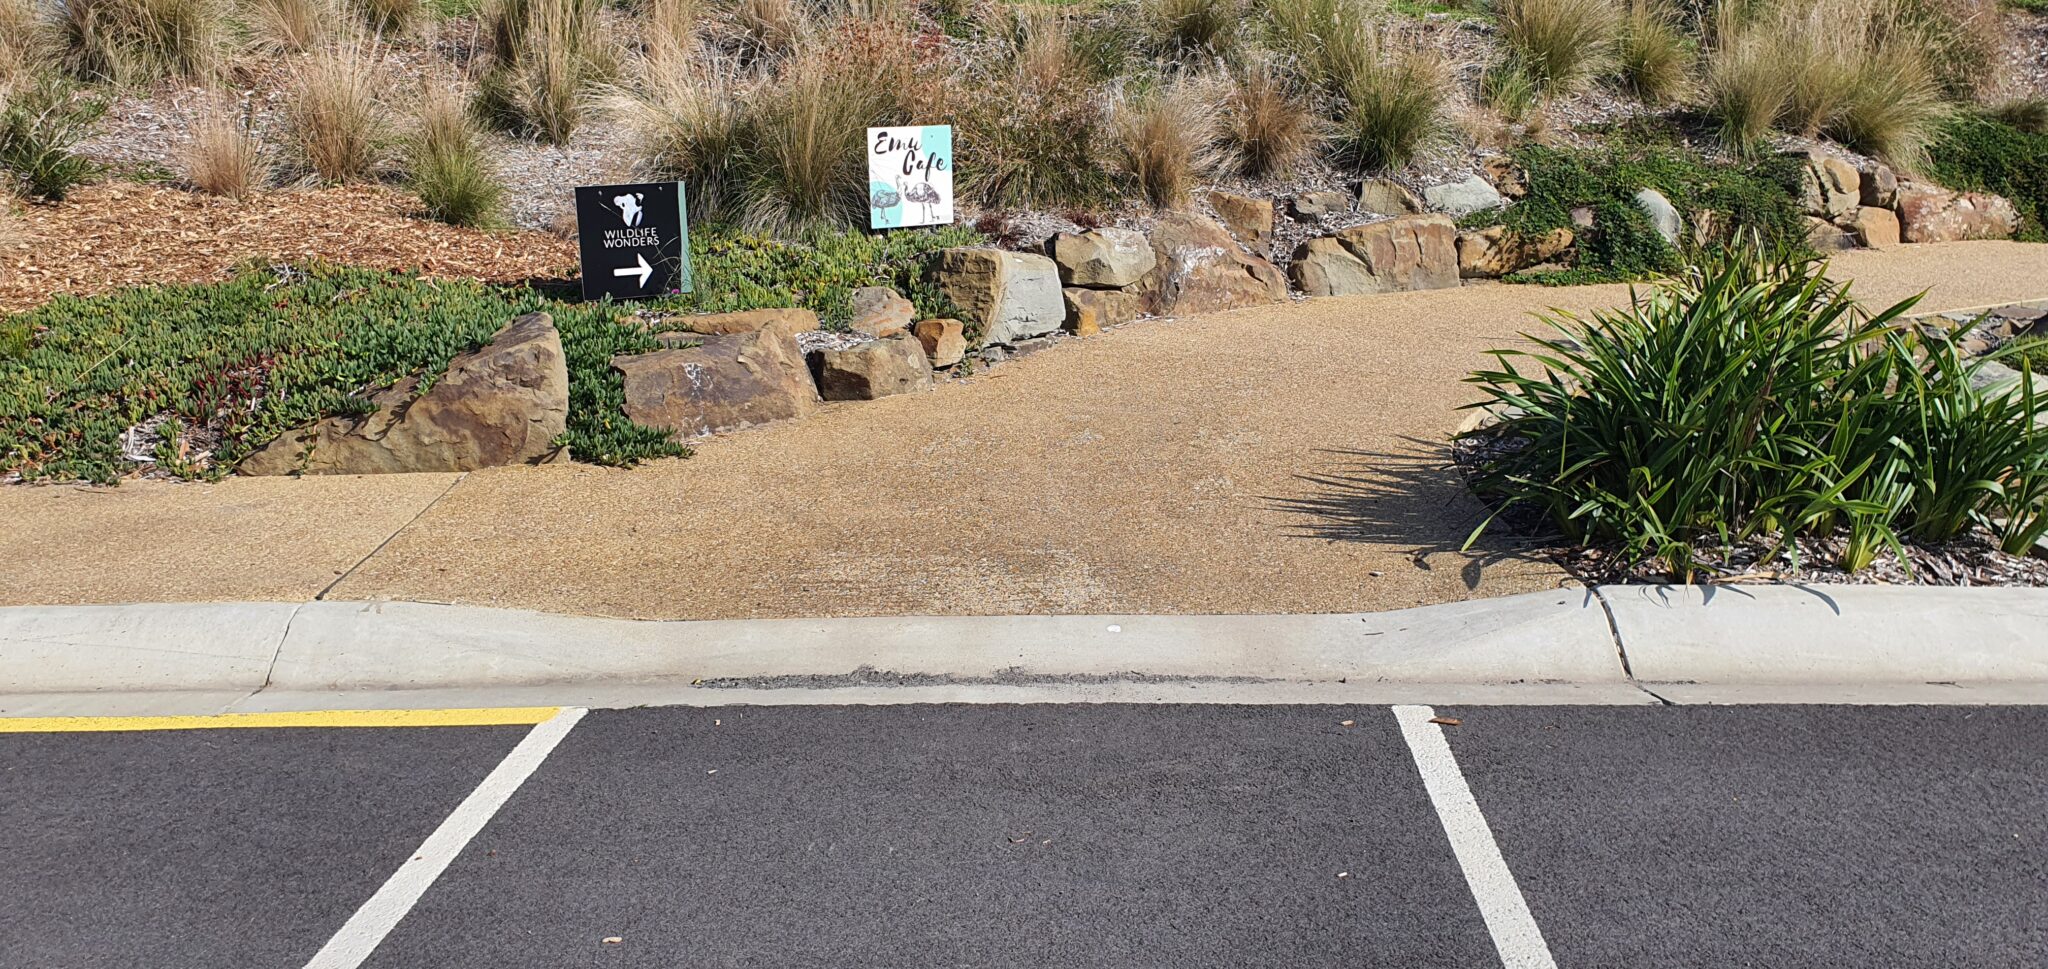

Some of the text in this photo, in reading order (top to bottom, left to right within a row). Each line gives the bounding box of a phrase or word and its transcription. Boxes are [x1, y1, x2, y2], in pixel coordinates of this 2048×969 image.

[874, 131, 922, 154] Emu
[903, 150, 948, 182] Cafe
[604, 227, 656, 238] WILDLIFE
[603, 236, 660, 248] WONDERS
